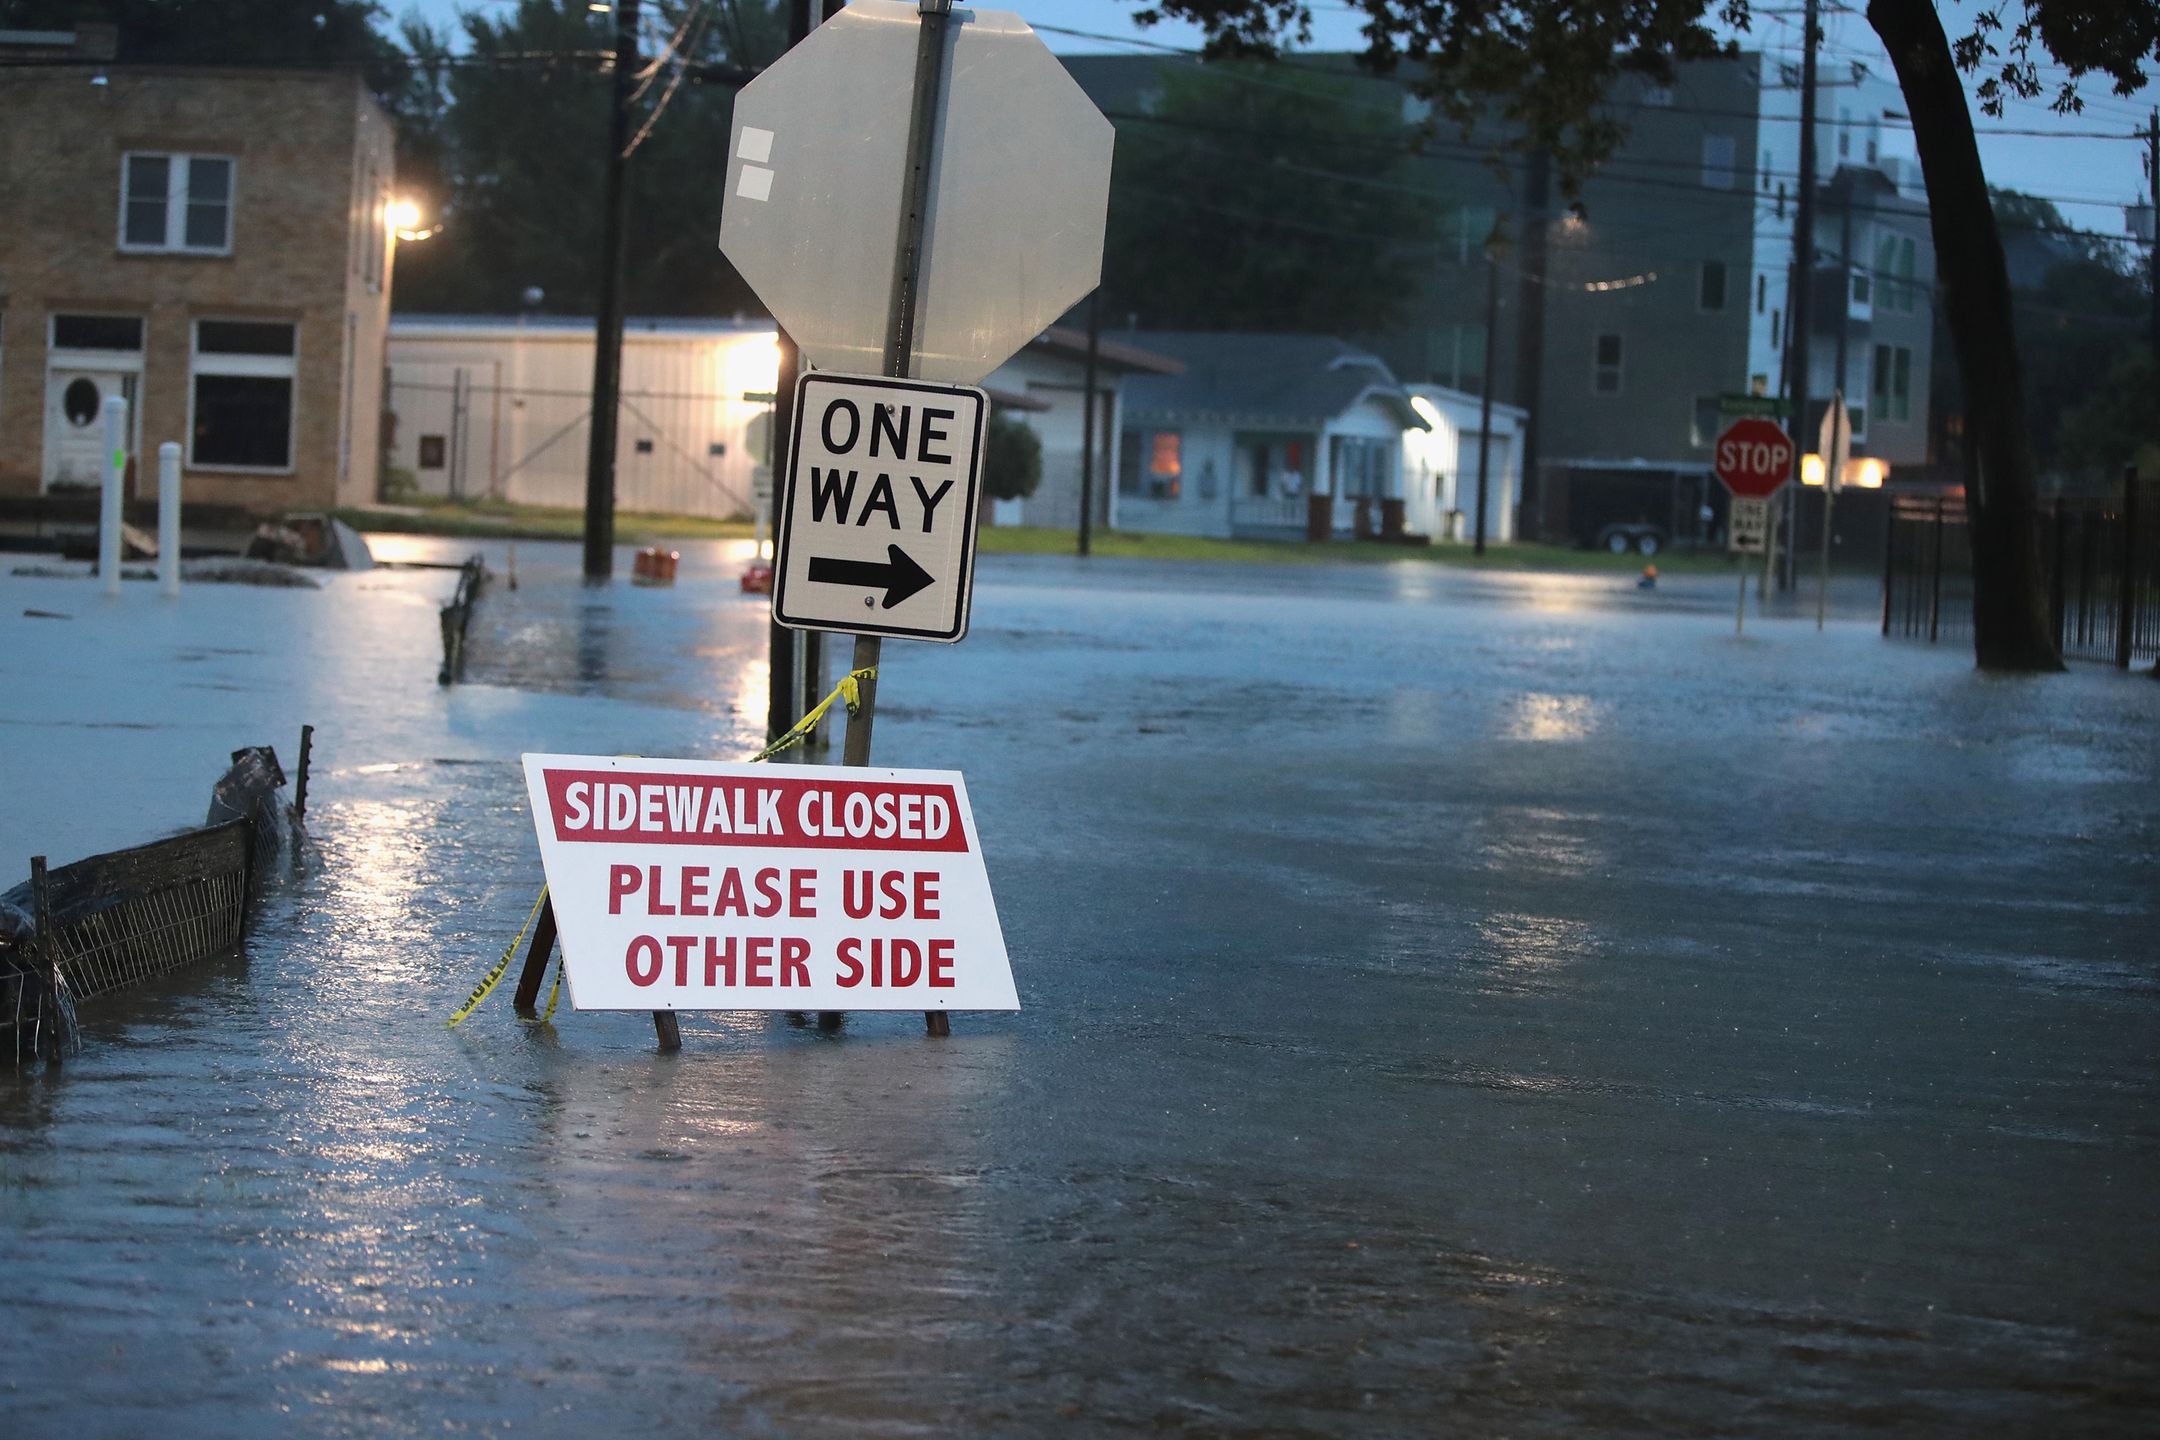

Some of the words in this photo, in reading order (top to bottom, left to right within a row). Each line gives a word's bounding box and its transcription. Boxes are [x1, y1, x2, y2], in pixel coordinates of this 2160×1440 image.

[821, 398, 955, 465] ONE
[1720, 441, 1788, 475] STOP
[811, 467, 955, 533] WAY
[564, 781, 784, 836] SIDEWALK
[798, 790, 951, 840] CLOSED
[609, 864, 817, 918] PLEASE
[844, 870, 940, 920] USE
[626, 935, 811, 987] OTHER
[837, 937, 955, 988] SIDE
